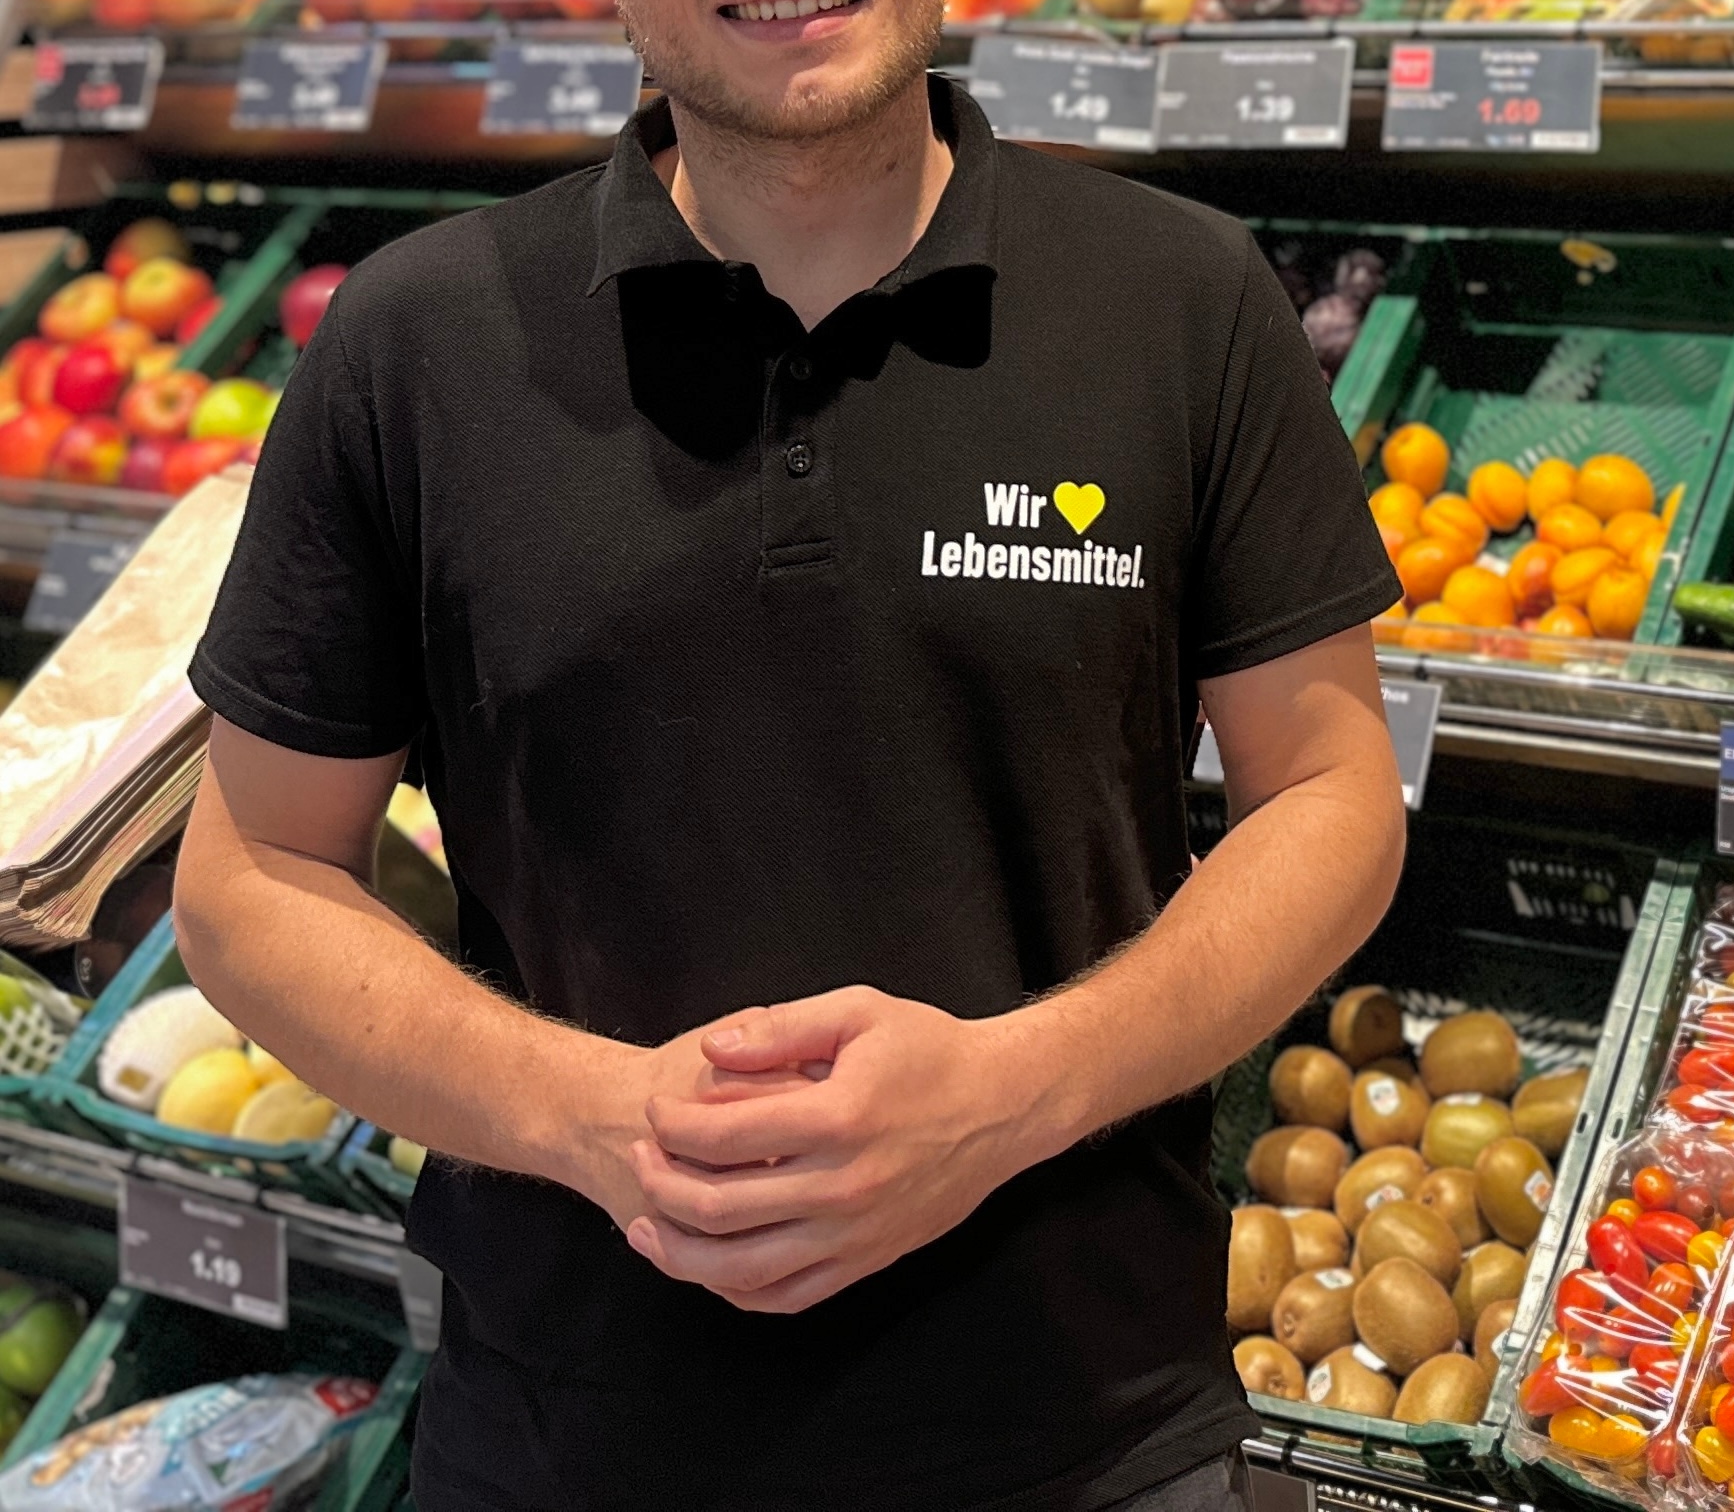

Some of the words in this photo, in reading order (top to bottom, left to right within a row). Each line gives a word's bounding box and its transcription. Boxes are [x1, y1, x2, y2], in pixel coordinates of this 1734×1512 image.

[1048, 93, 1110, 122] 1.49
[1236, 95, 1294, 123] 1.39
[984, 482, 1047, 528] Wir
[921, 530, 1145, 589] Lebensmittel.
[190, 1249, 242, 1287] 1.19
